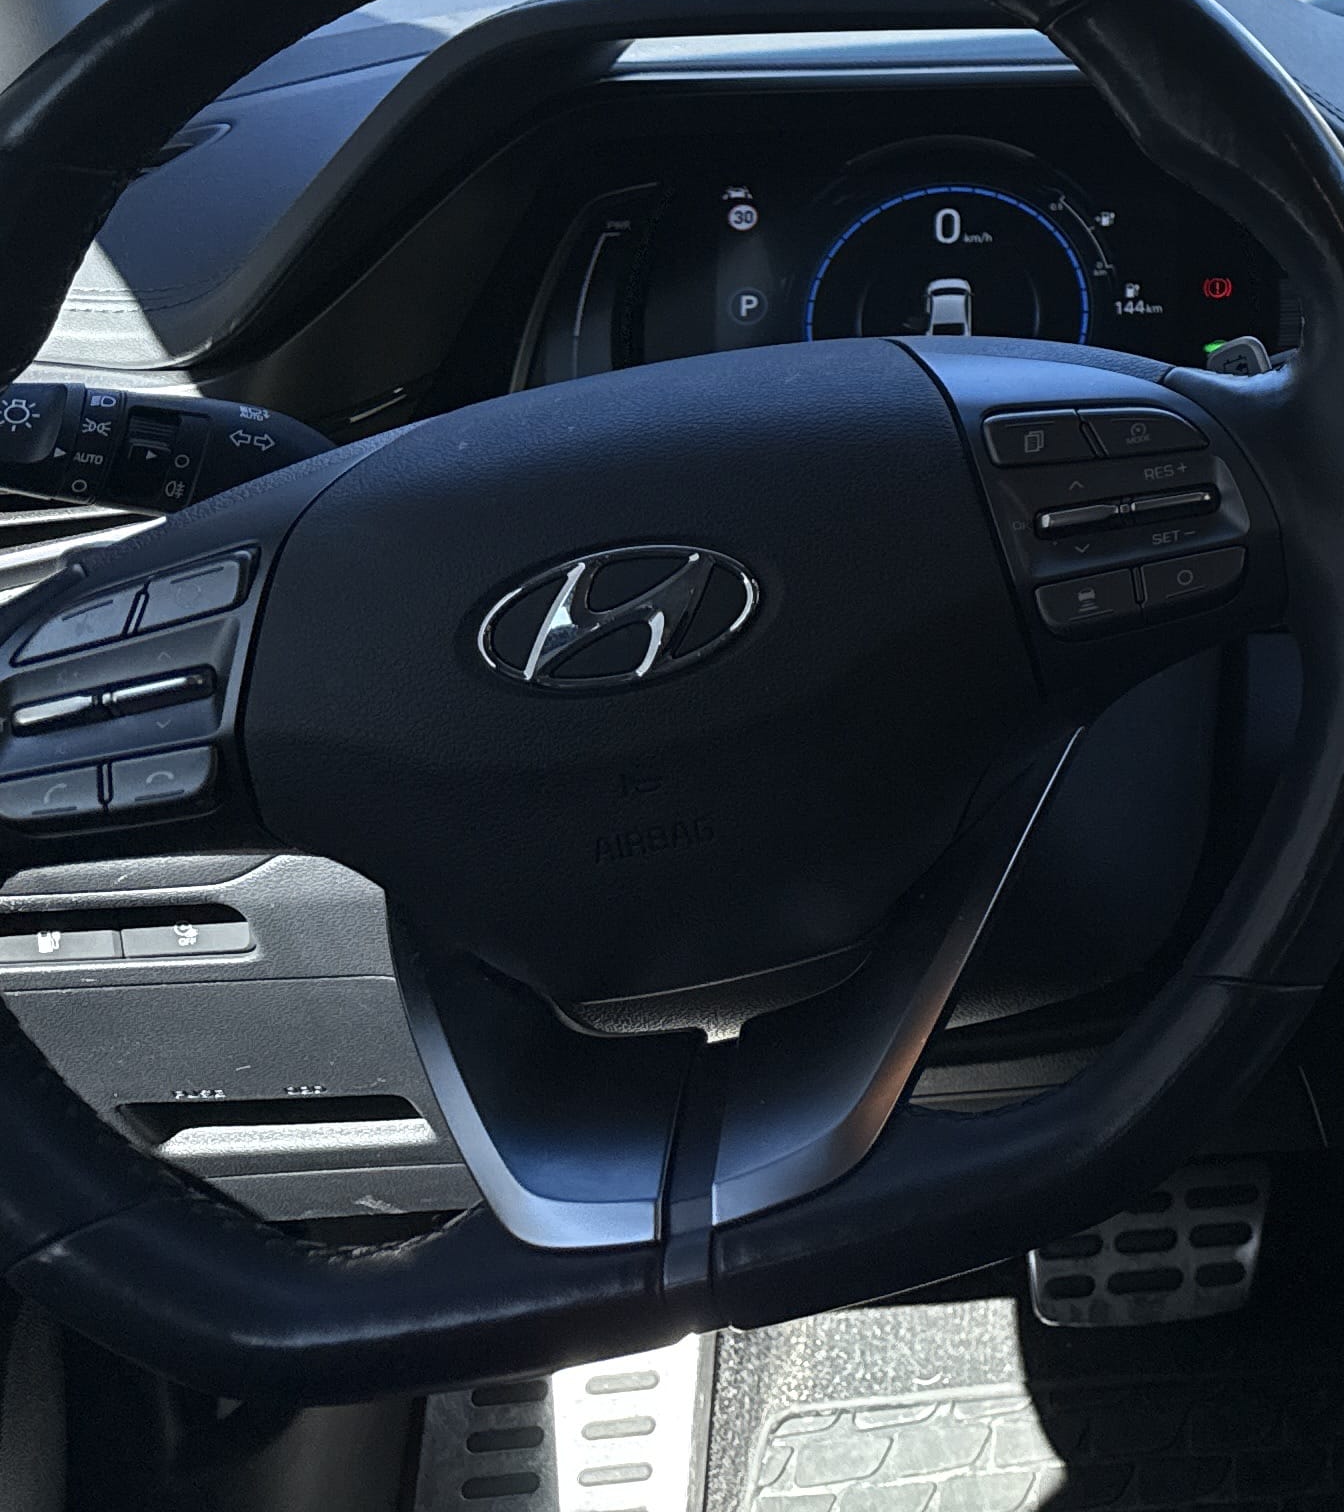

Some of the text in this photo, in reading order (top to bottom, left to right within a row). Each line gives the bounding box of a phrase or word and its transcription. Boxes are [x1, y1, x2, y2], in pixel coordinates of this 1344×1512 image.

[733, 210, 754, 225] 30
[935, 207, 993, 245] 0 km/h
[740, 294, 760, 317] P
[73, 450, 104, 466] AUTO
